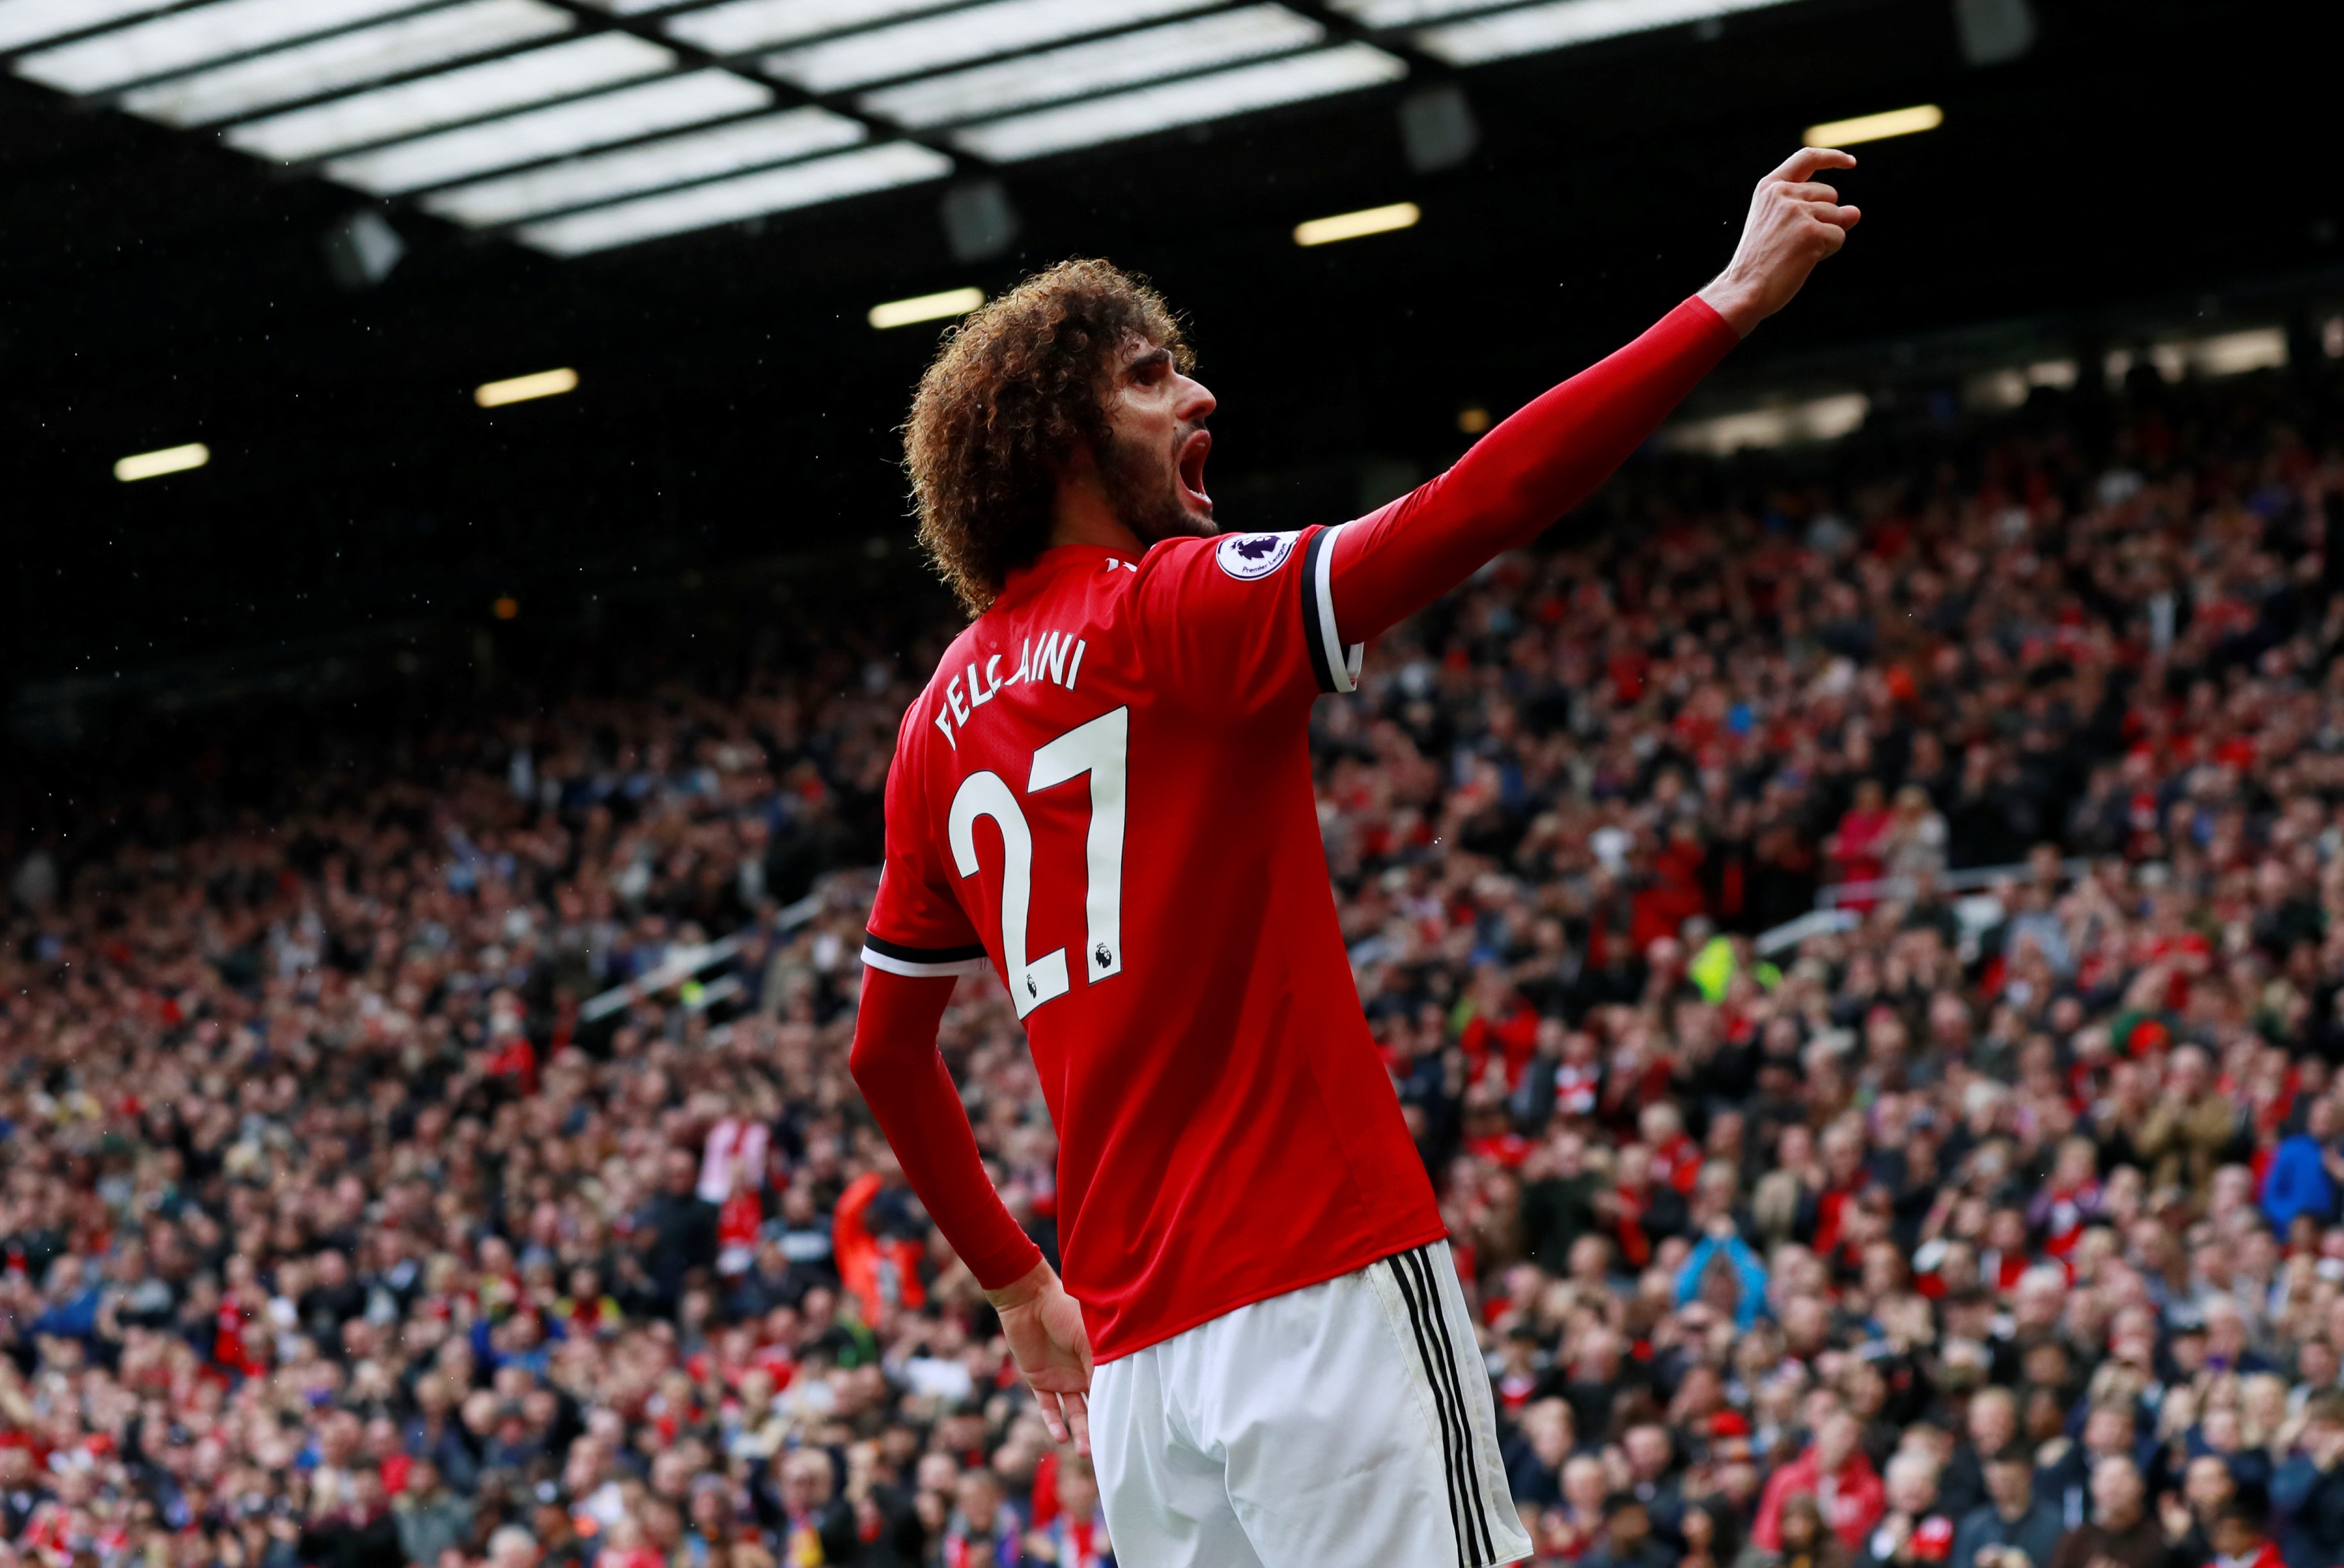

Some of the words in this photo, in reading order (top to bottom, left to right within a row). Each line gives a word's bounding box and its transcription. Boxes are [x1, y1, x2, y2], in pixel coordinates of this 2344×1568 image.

[1242, 564, 1268, 573] Premier
[1268, 543, 1287, 565] League
[948, 704, 1128, 1021] 27
